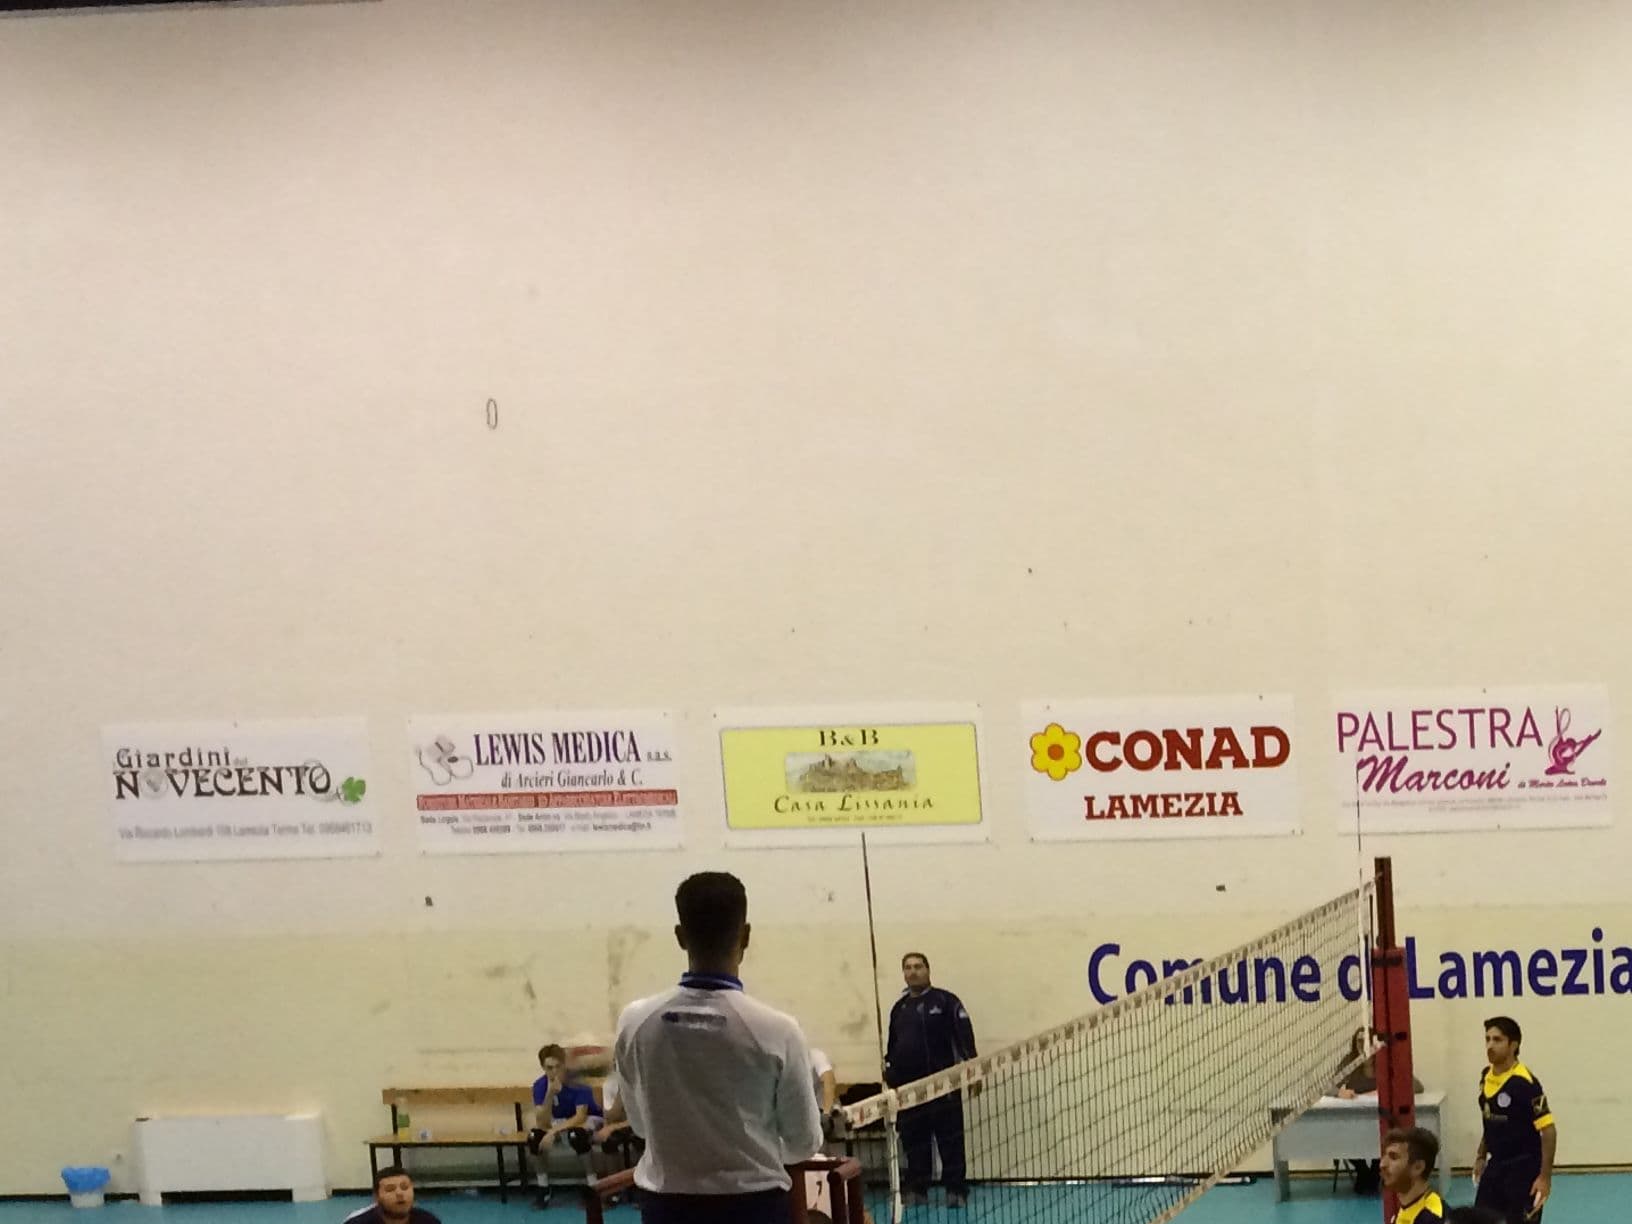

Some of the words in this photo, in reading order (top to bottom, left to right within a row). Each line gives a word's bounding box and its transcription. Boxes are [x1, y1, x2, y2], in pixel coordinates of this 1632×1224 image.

[1337, 707, 1543, 752] PALESTRA
[116, 747, 231, 769] Giardini
[474, 732, 546, 766] LEWIS
[552, 730, 641, 763] MEDICA
[1085, 726, 1290, 772] CONAD
[501, 773, 511, 788] di
[557, 769, 613, 787] Giancarlo
[617, 771, 626, 785] &
[631, 770, 643, 786] C.
[1357, 754, 1511, 793] Marconi
[774, 795, 825, 814] Casa
[1084, 792, 1243, 820] LAMEZIA
[1088, 942, 1321, 1005] Comune
